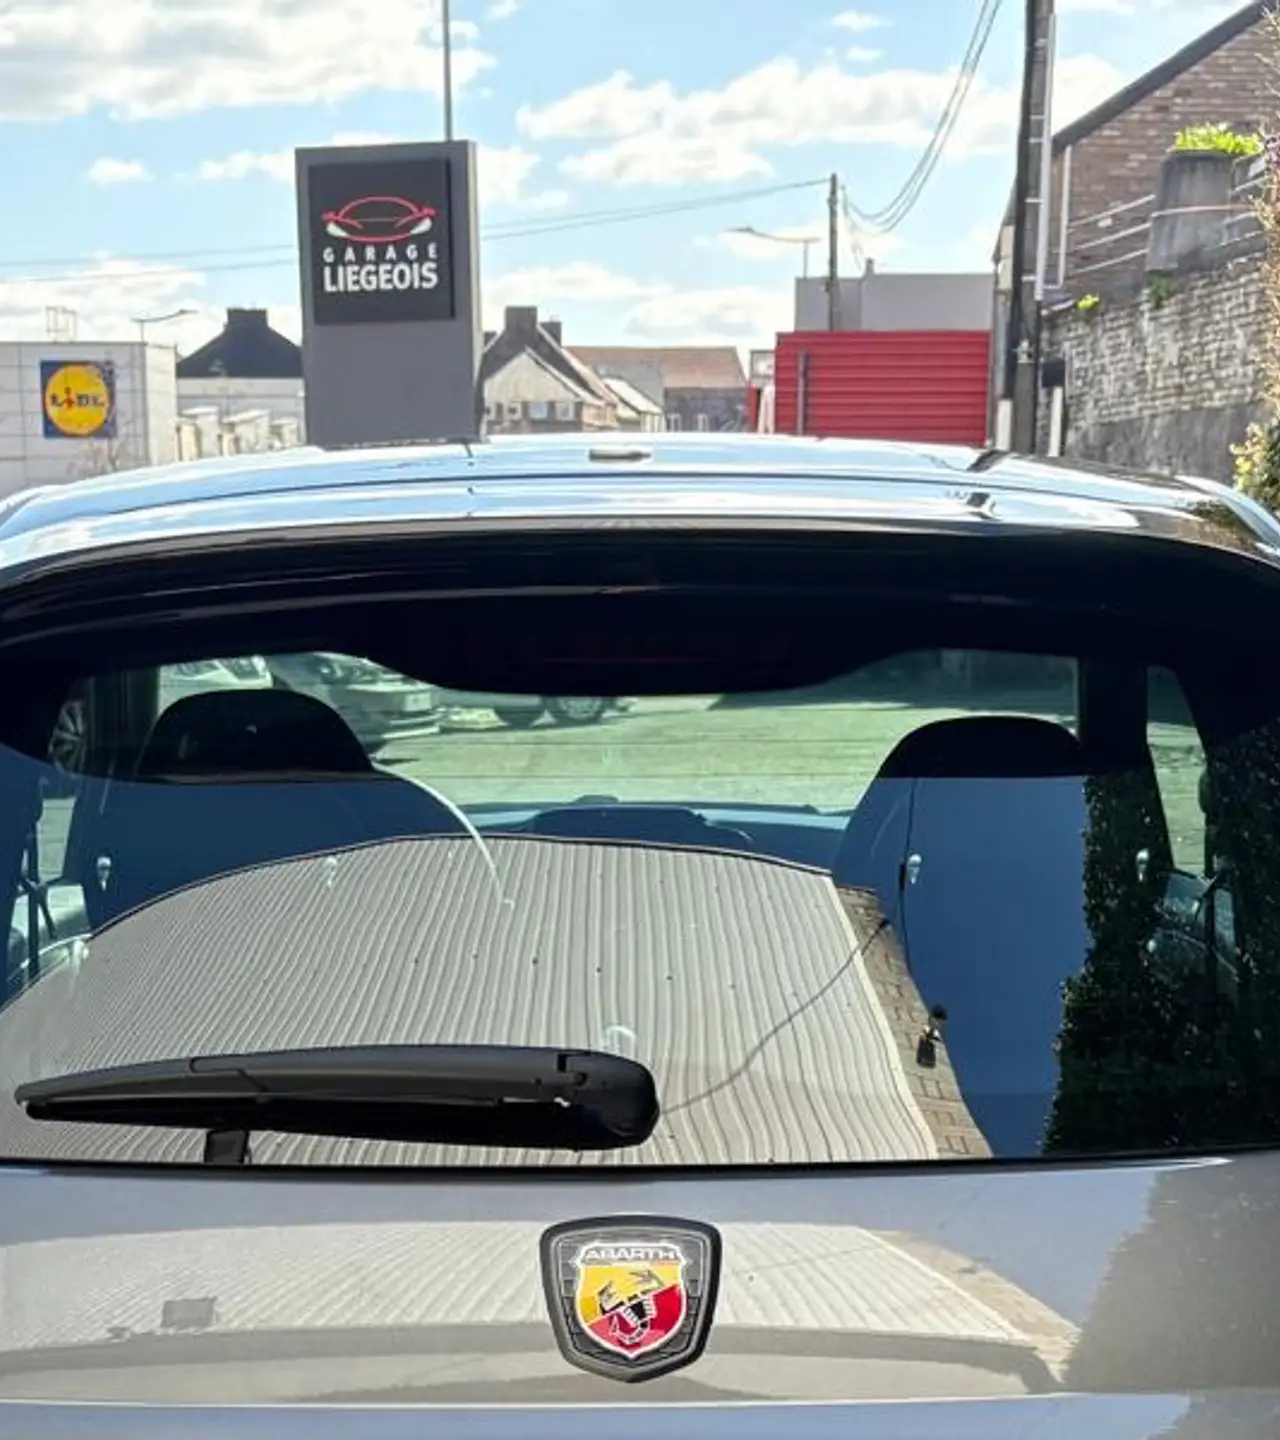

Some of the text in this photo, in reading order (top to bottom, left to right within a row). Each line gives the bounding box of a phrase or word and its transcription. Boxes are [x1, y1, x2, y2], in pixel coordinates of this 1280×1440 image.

[323, 242, 438, 262] GARAGE
[323, 262, 439, 292] LIEGEOIS
[586, 1247, 675, 1261] ABARTH
